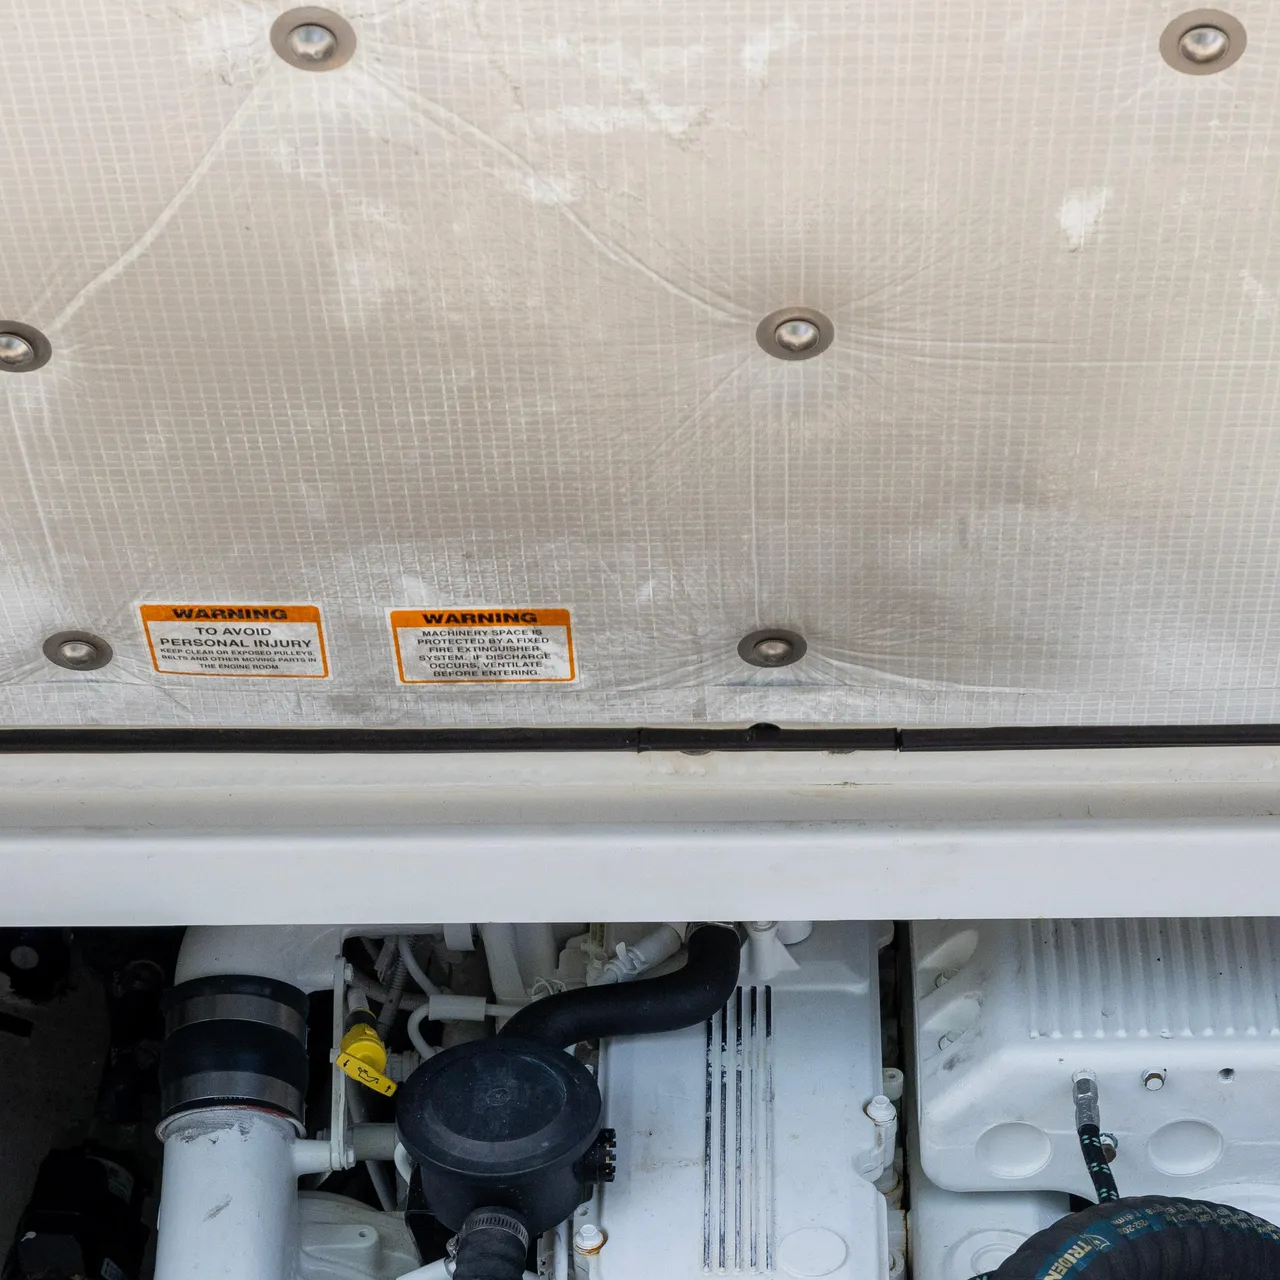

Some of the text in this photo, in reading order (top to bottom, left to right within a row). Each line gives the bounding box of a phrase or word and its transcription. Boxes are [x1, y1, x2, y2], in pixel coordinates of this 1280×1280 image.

[172, 607, 288, 620] WARNING
[422, 612, 538, 625] WARNING
[195, 627, 272, 636] TO AVOID
[422, 629, 488, 637] MACHINERY
[160, 638, 312, 648] PERSONAL INJURY
[457, 645, 540, 653] EXTINGUISHER
[429, 661, 543, 670] OCCURS, VENTILATE
[481, 669, 541, 677] ENTERING.
